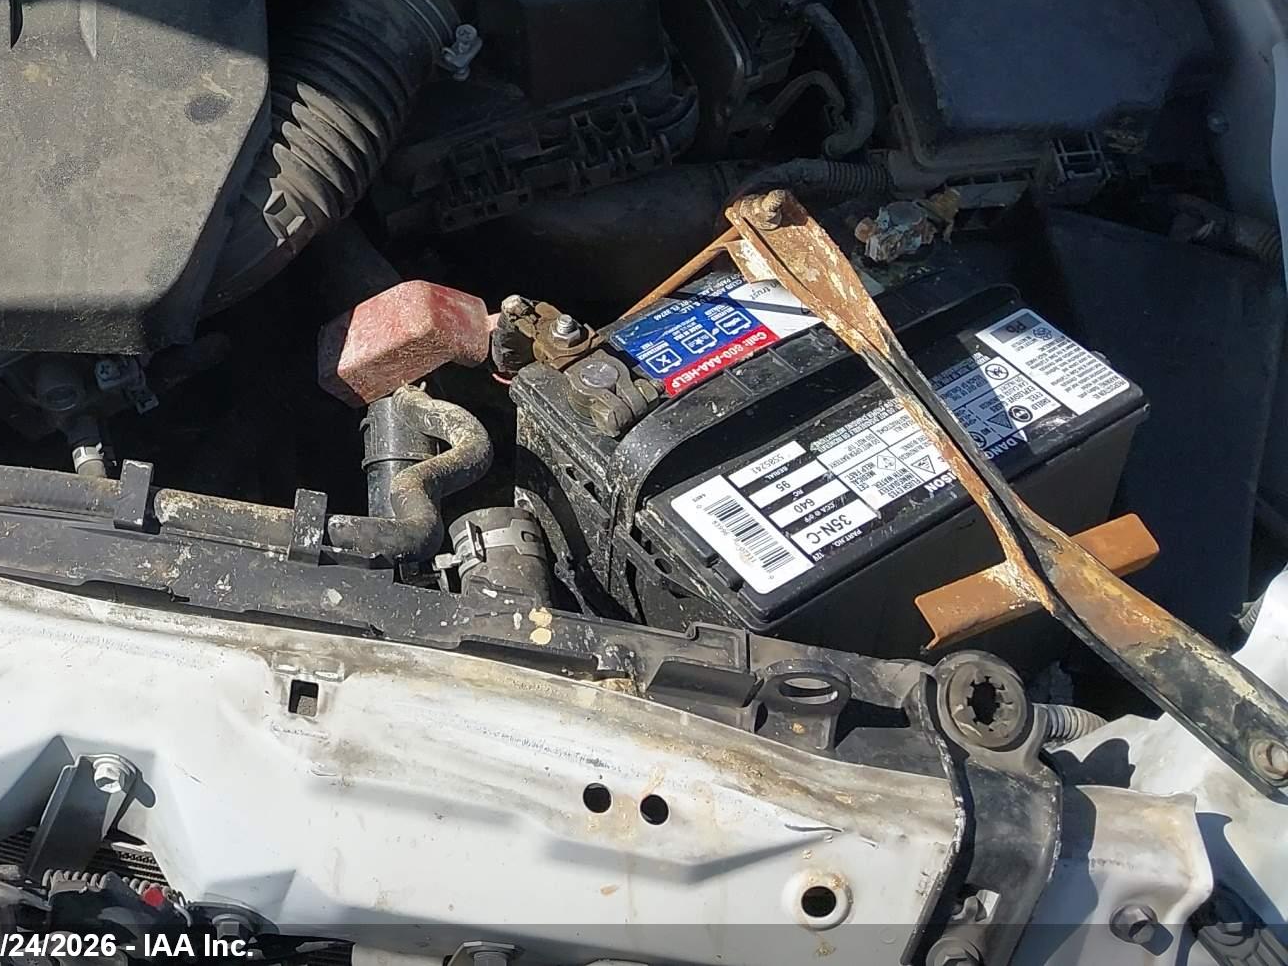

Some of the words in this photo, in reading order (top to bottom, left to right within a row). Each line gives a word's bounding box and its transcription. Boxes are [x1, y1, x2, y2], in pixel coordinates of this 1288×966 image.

[749, 286, 771, 300] trust
[1004, 320, 1027, 336] Pb
[743, 330, 767, 348] Call:
[669, 343, 744, 388] 800-AAA-HELP
[765, 465, 788, 480] SERIAL
[775, 479, 791, 492] 95
[887, 487, 904, 498] EYES
[793, 497, 815, 513] 640
[820, 502, 834, 512] CCA
[804, 512, 852, 545] 35N-C
[843, 528, 861, 541] PART
